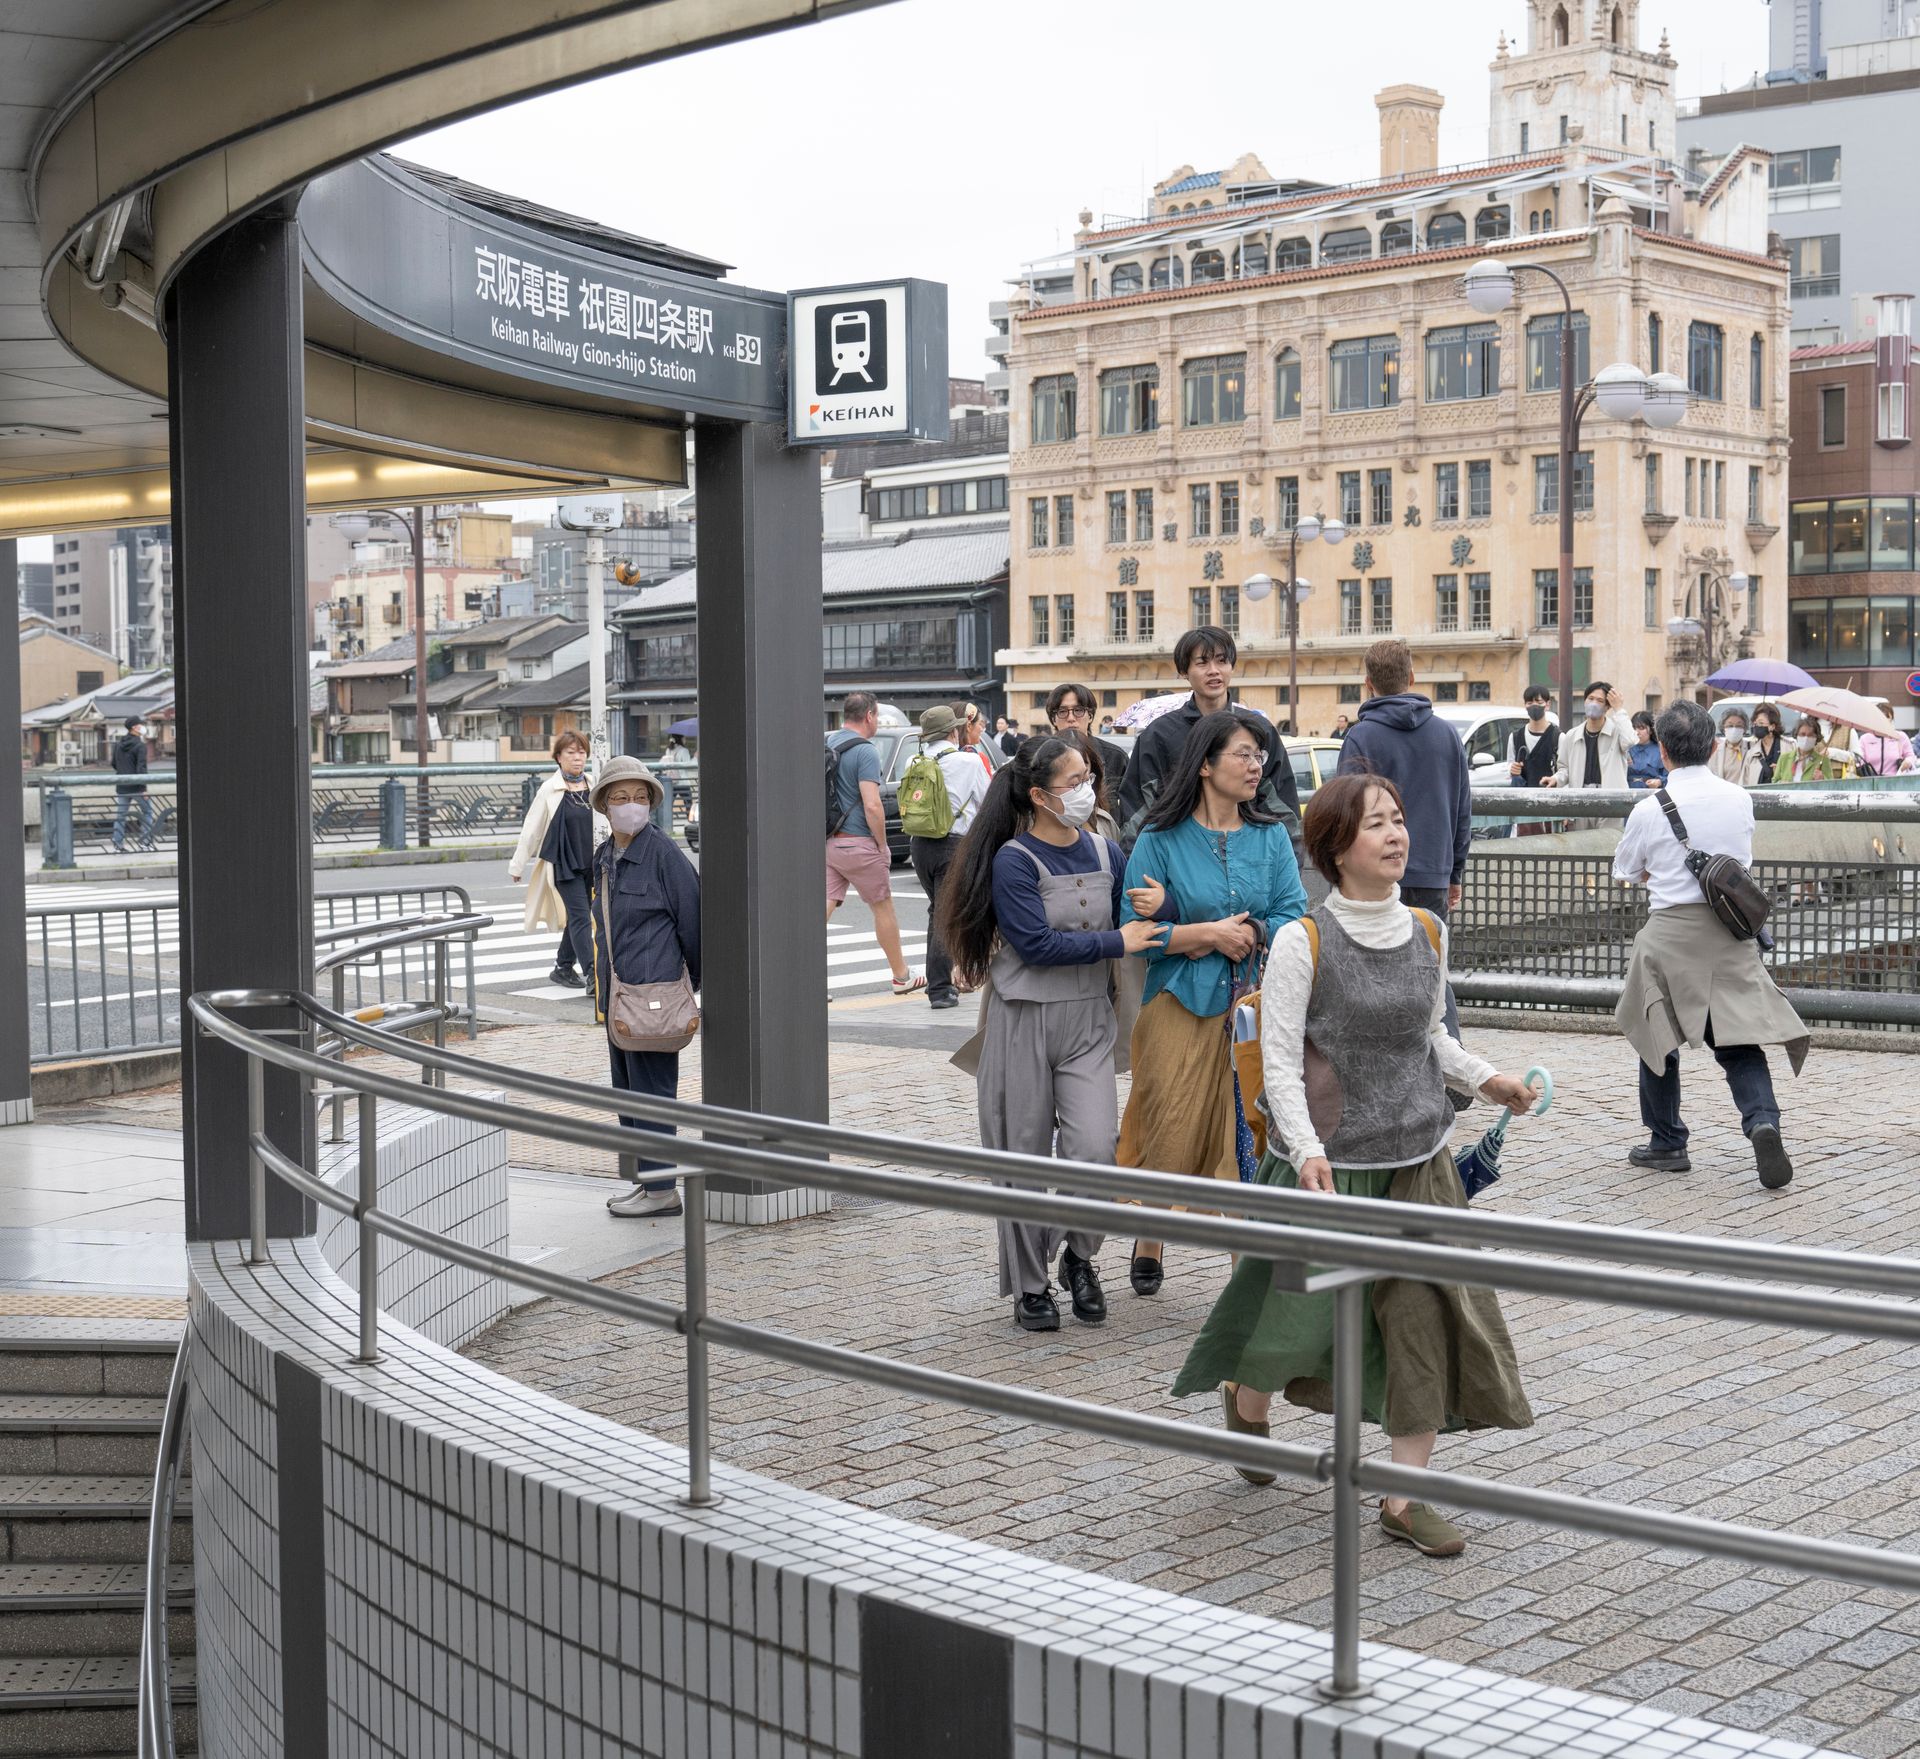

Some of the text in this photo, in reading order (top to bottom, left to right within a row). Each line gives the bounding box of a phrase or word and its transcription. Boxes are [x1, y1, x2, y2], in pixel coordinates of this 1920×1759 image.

[475, 246, 714, 356] 京阪電車 祇園四条駅
[491, 315, 696, 383] Keihan Railway Gion-shijo Station
[823, 405, 894, 422] KEIHAN
